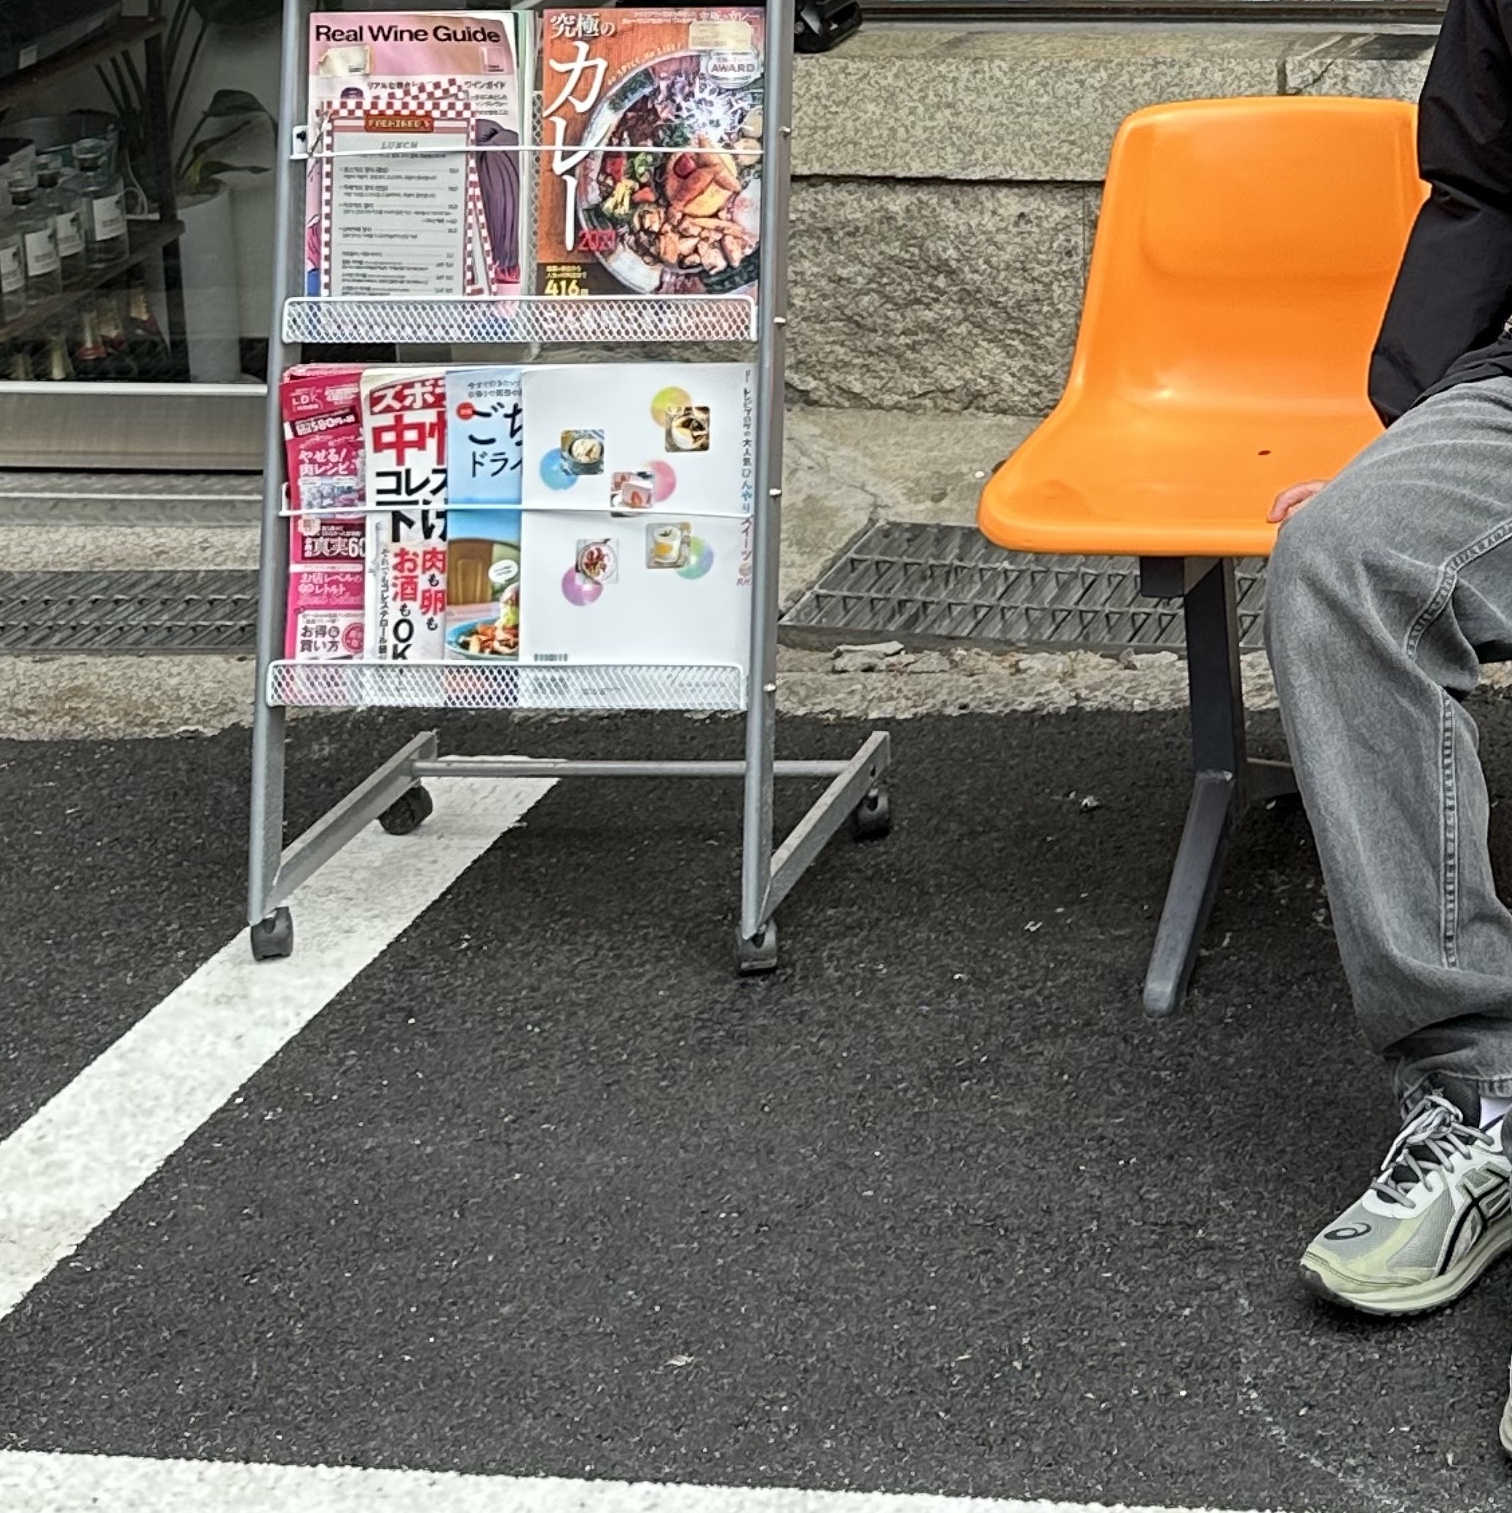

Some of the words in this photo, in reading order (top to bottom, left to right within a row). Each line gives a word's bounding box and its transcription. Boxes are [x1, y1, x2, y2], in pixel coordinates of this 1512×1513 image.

[315, 24, 363, 42] Real
[369, 24, 429, 42] Wine
[433, 25, 501, 43] Guide
[550, 11, 616, 38] 究極の
[711, 63, 756, 73] AWARD
[545, 41, 607, 252] カレー
[420, 546, 447, 631] 肉も卵も
